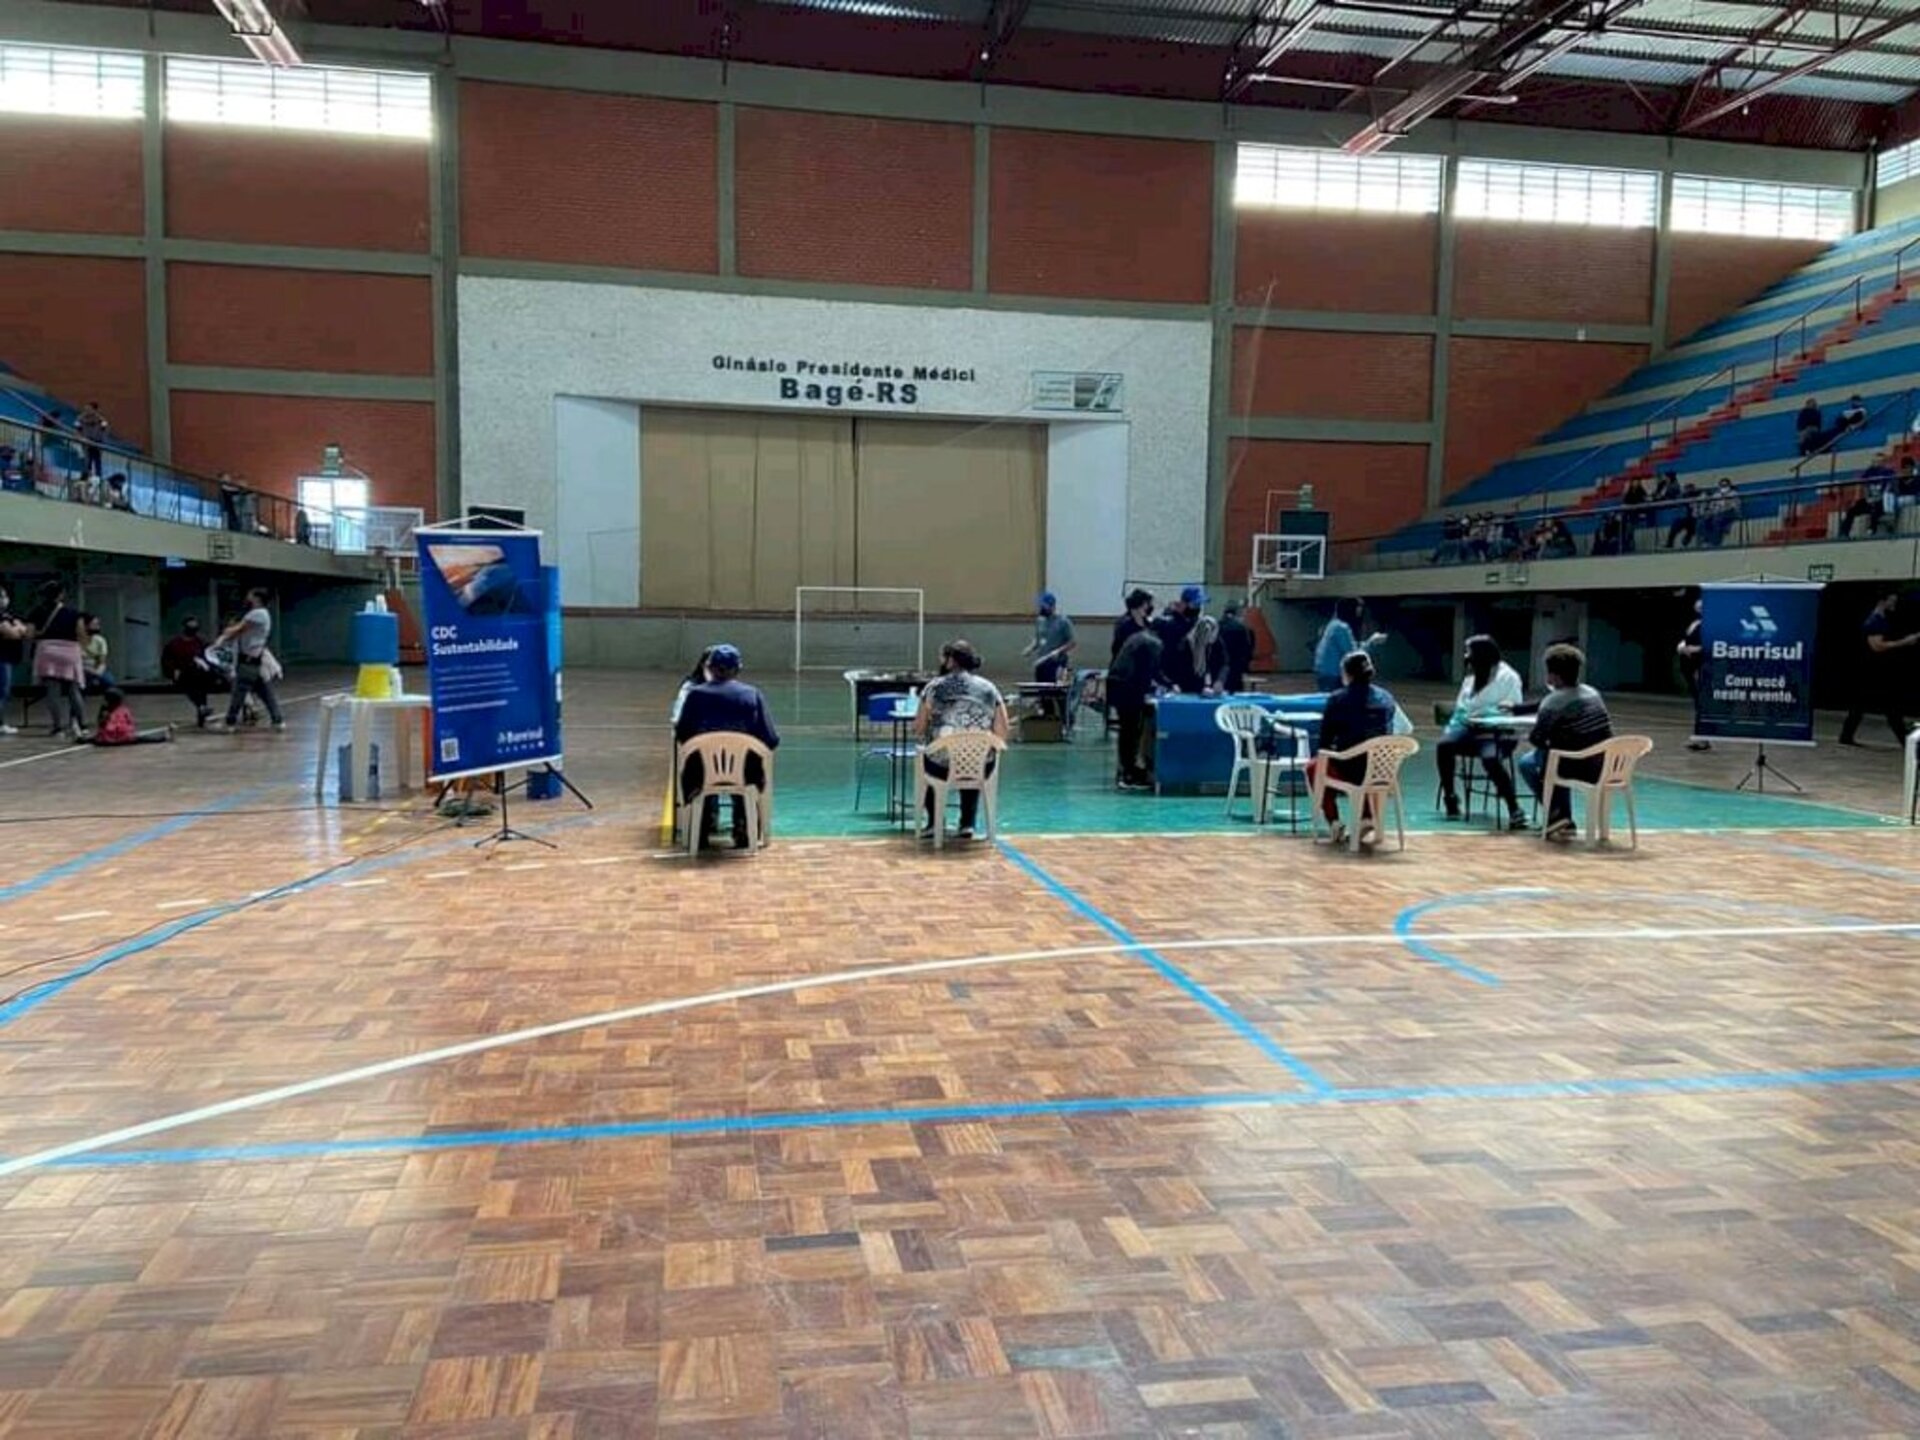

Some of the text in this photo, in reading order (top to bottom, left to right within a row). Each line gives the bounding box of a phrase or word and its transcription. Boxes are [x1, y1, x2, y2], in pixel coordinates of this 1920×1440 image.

[712, 356, 975, 381] Ginásio Presidente Médici
[780, 377, 918, 405] Bagé-RS
[431, 625, 458, 640] CDC
[432, 636, 518, 655] Sustentabilidade
[1712, 641, 1803, 660] Banrisul
[1725, 674, 1786, 688] Com você
[1713, 688, 1796, 703] neste evento.
